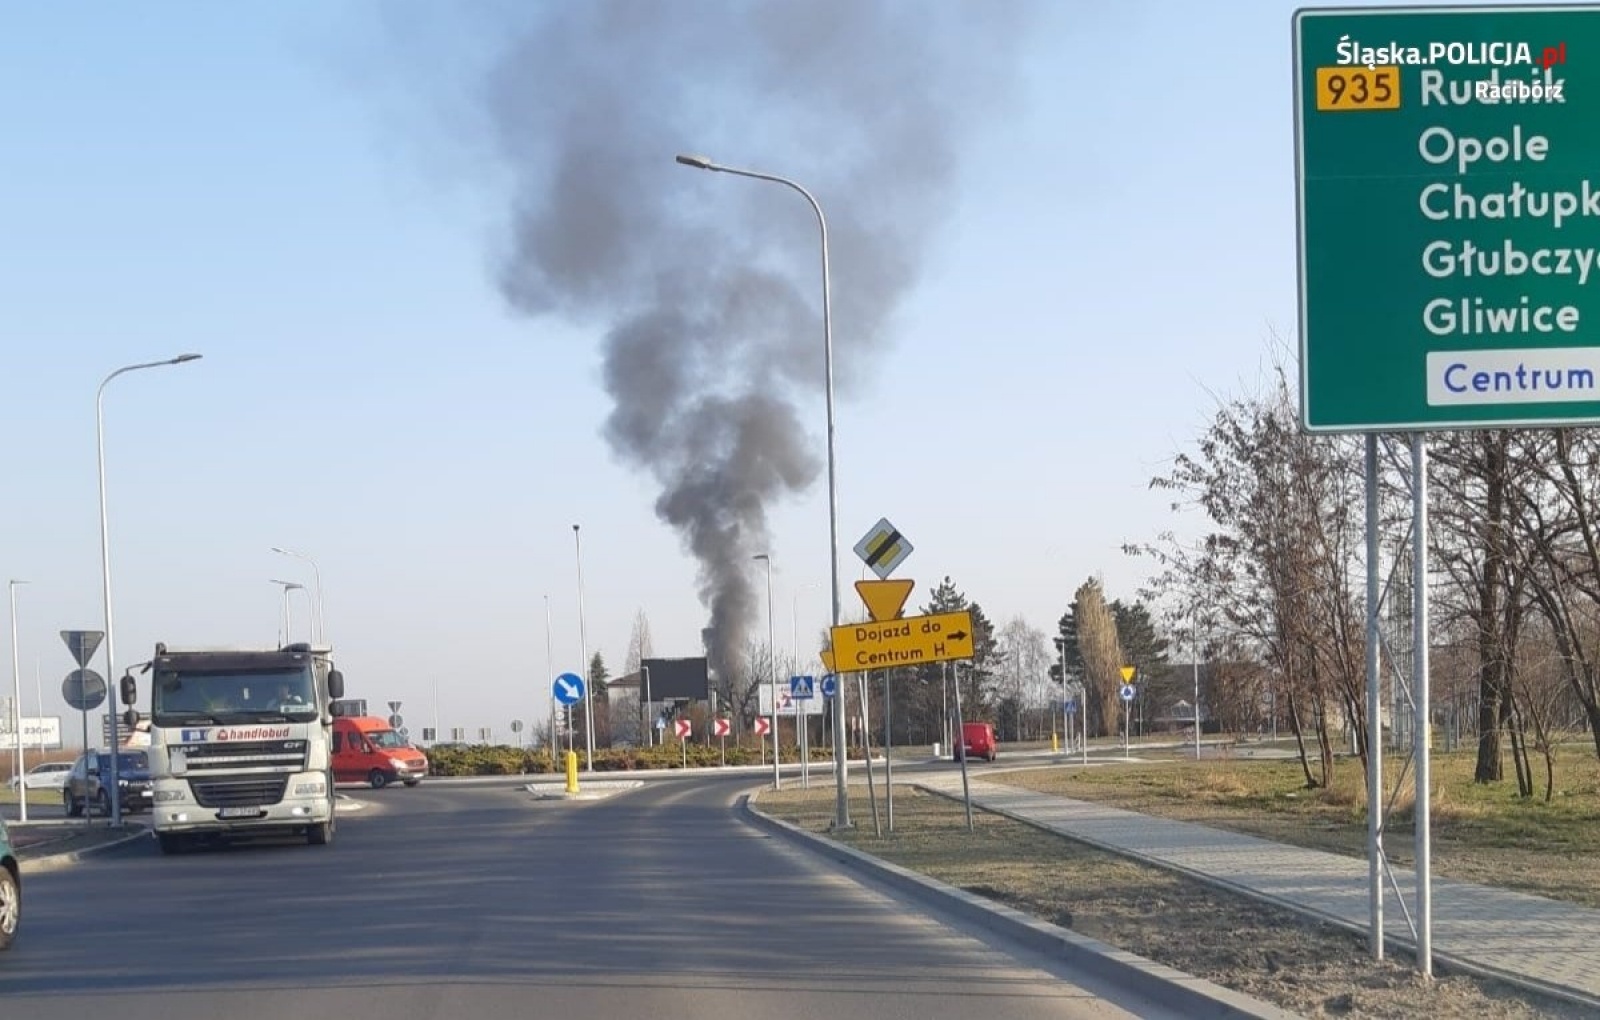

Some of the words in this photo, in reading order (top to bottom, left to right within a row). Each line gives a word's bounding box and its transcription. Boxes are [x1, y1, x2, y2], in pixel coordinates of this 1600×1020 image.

[1327, 73, 1392, 105] 935
[1418, 124, 1549, 173] Opole
[1422, 239, 1600, 285] Głubczy
[1423, 296, 1580, 335] Gliwice
[1443, 363, 1594, 393] Centrum
[855, 622, 911, 643] Dojazd
[921, 619, 941, 634] do
[855, 648, 924, 665] Centrum
[229, 727, 290, 740] handlobud
